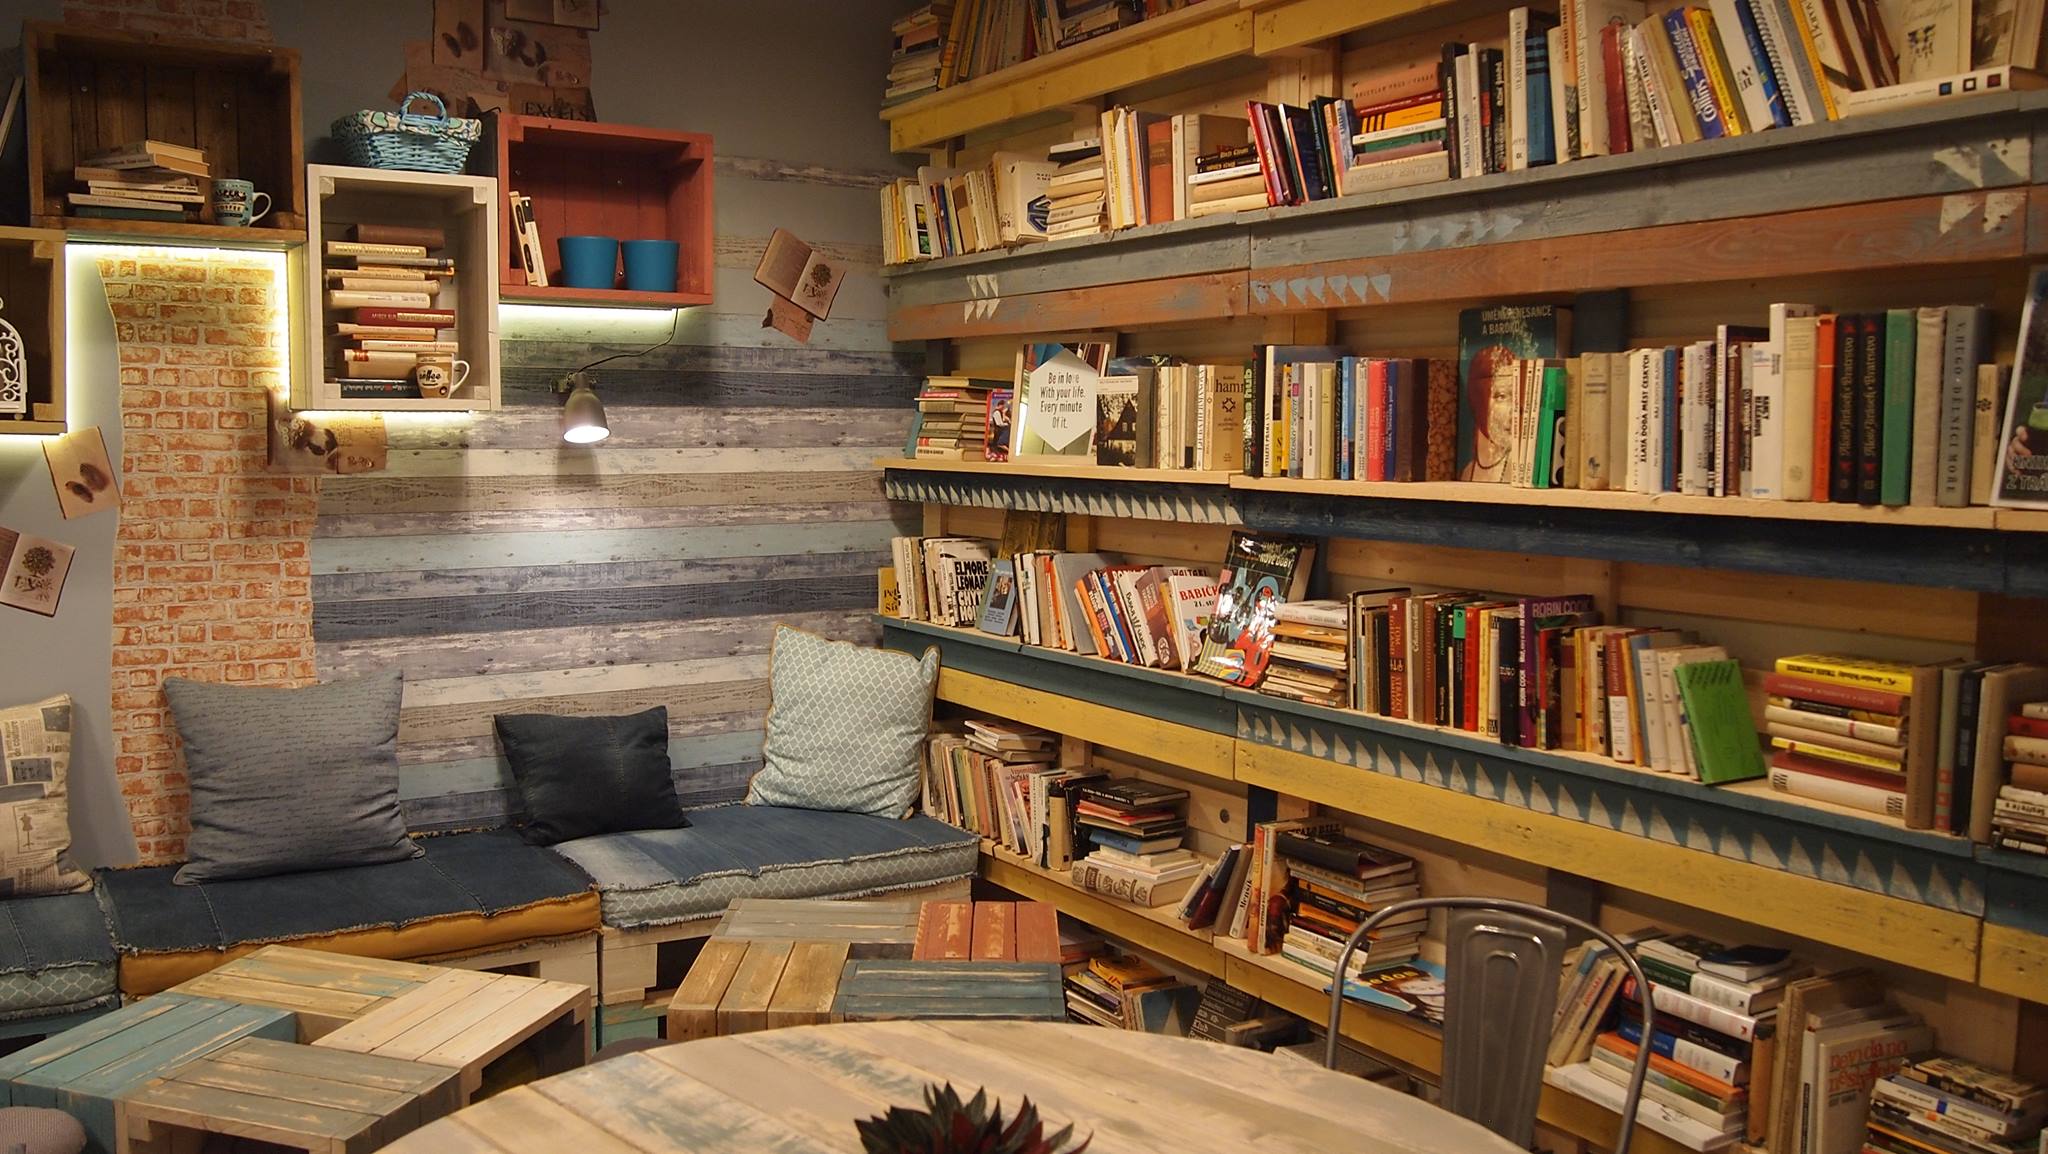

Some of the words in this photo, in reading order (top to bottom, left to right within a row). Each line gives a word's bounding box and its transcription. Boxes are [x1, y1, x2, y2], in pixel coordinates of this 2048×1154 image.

[1698, 79, 1717, 122] Collins
[1049, 372, 1057, 384] Be
[1058, 372, 1065, 383] in
[1066, 371, 1080, 383] loe
[1642, 353, 1651, 388] ČESKÝCH
[1041, 387, 1055, 399] With
[1056, 387, 1071, 401] your
[1072, 386, 1086, 399] life.
[1641, 390, 1649, 411] MĚST
[1041, 401, 1058, 415] Every
[1059, 401, 1083, 413] minute
[1052, 418, 1060, 429] Of
[1061, 418, 1069, 429] it.
[954, 561, 989, 576] ELMORE
[1532, 600, 1562, 618] ROBIN
